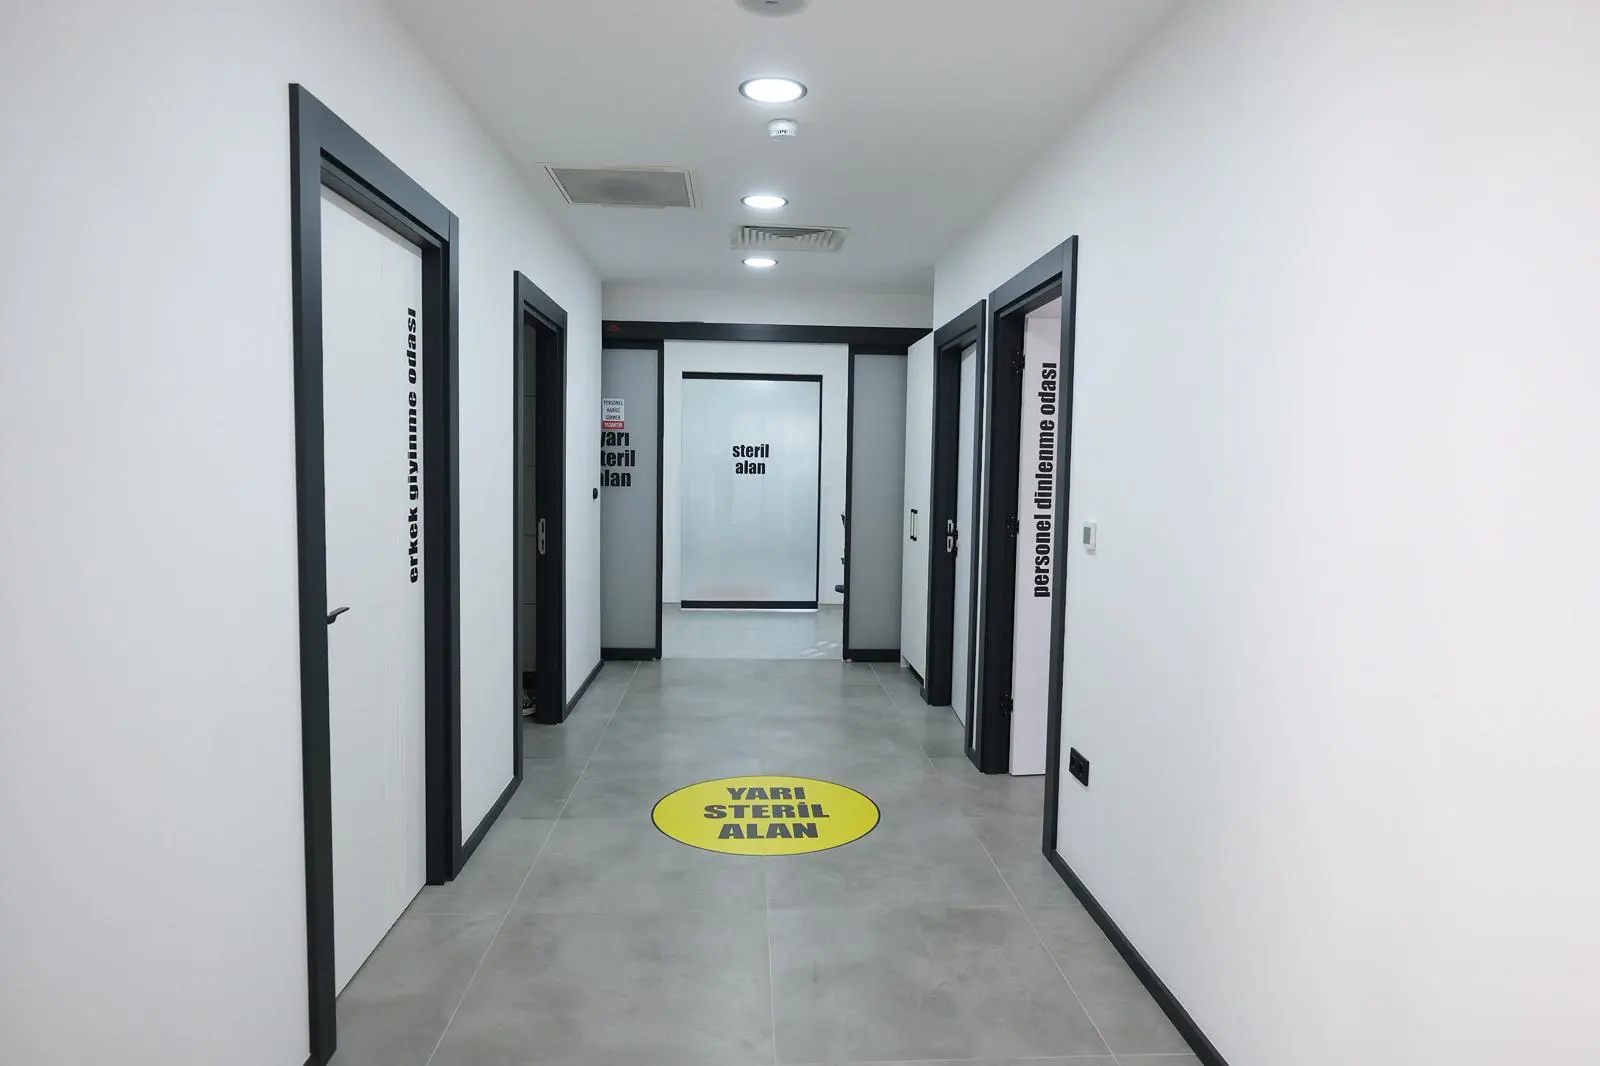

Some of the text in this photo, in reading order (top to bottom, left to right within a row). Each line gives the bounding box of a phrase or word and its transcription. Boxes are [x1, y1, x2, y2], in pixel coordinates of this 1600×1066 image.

[406, 307, 419, 584] erkek giyinme odası
[732, 443, 770, 458] steril
[600, 449, 636, 467] teril
[735, 459, 766, 475] alan
[1033, 362, 1058, 598] personel dinlenme odası
[726, 786, 806, 801] YARI
[703, 801, 830, 819] STERİL
[718, 822, 819, 840] ALAN
